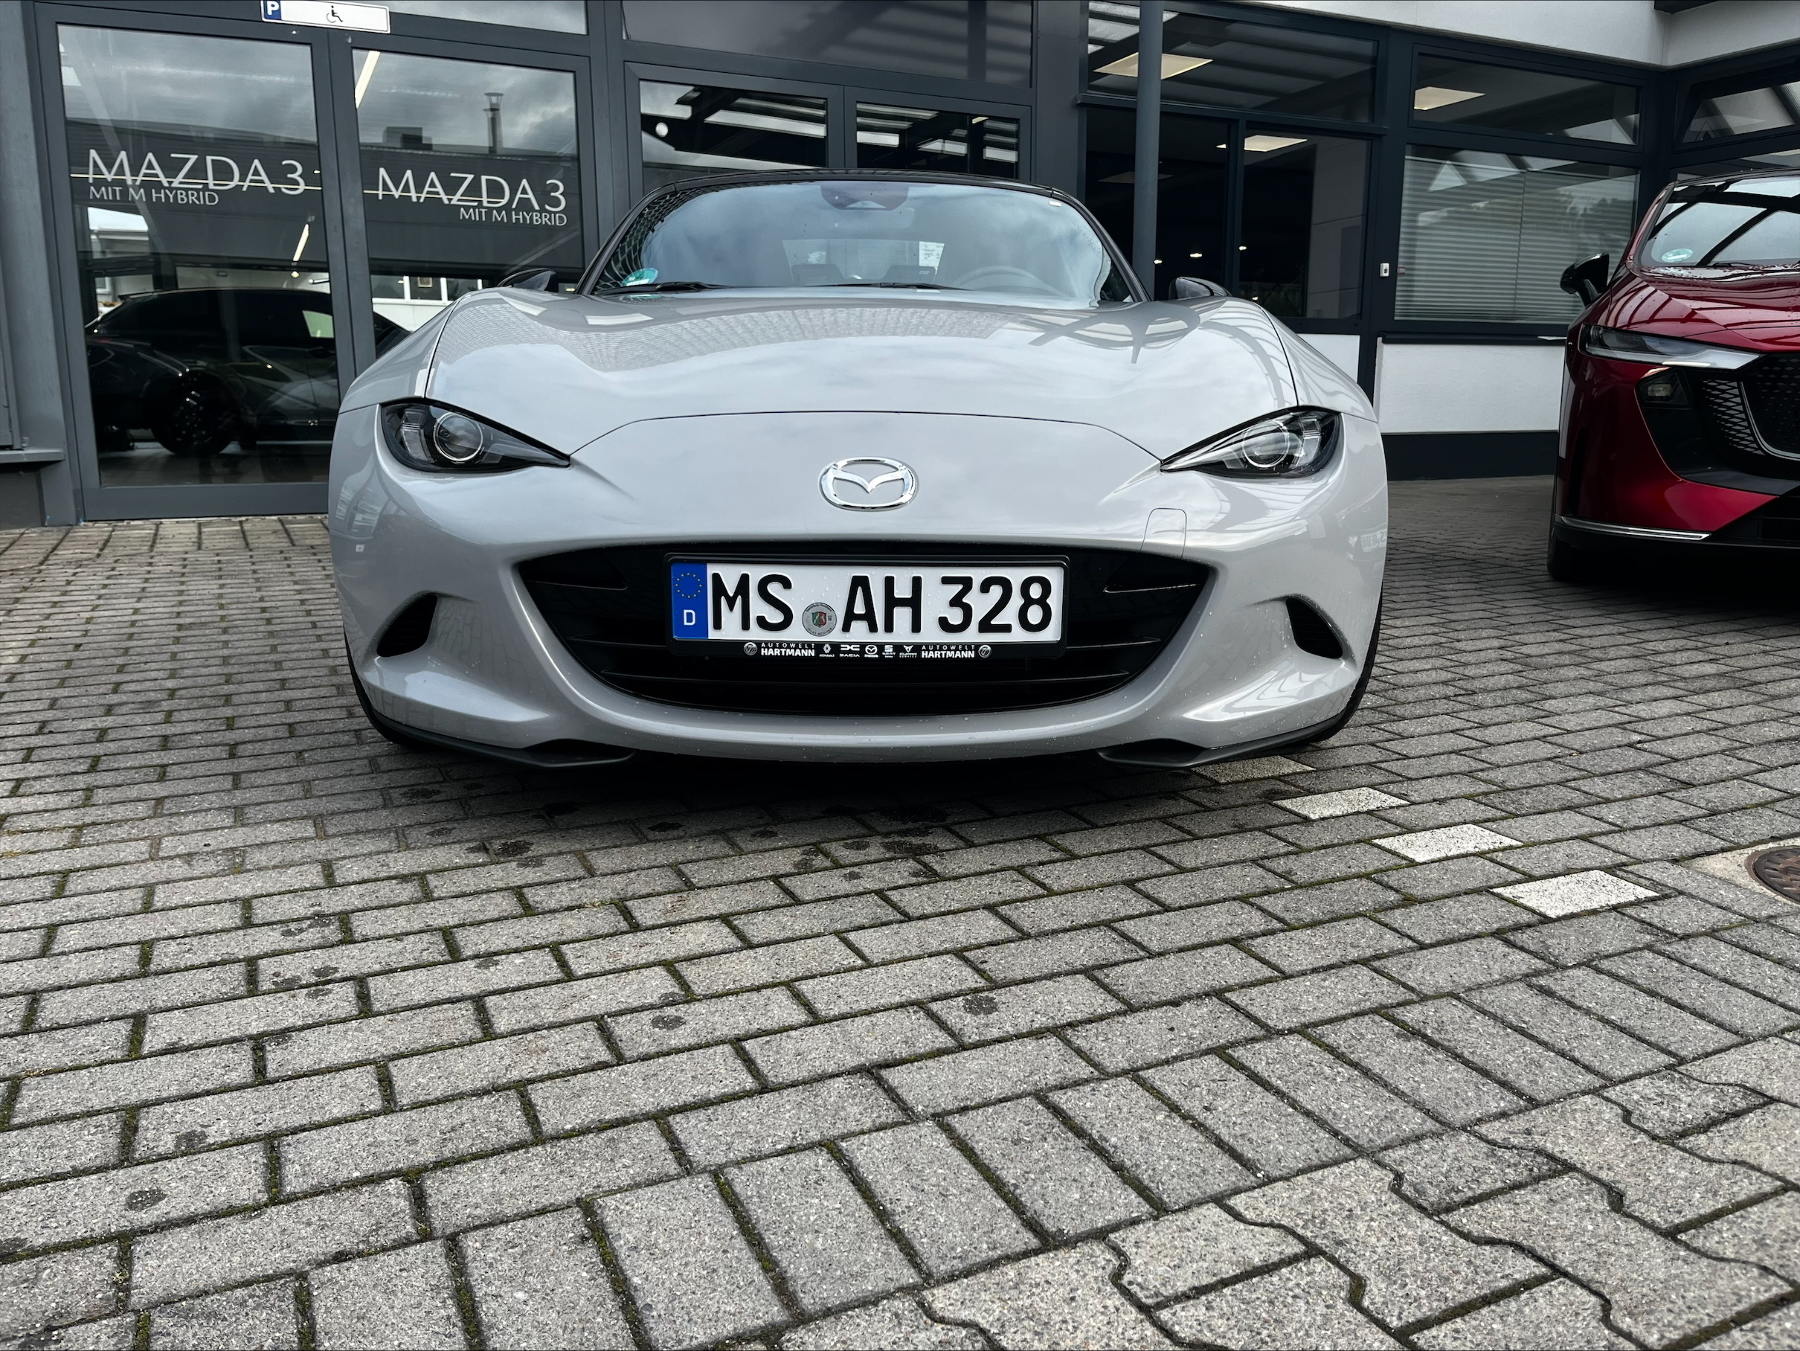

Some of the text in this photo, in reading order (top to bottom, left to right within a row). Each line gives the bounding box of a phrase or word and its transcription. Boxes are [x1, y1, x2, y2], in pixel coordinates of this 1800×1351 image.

[267, 0, 280, 16] P
[88, 149, 306, 195] MAZDA3
[89, 186, 219, 206] MIT M HYBRID
[459, 207, 568, 226] MIT M HYBRID
[711, 572, 1052, 634] MS AH 328
[683, 609, 696, 626] D
[760, 648, 815, 657] HARTMANN
[921, 650, 975, 659] HARTMANN
